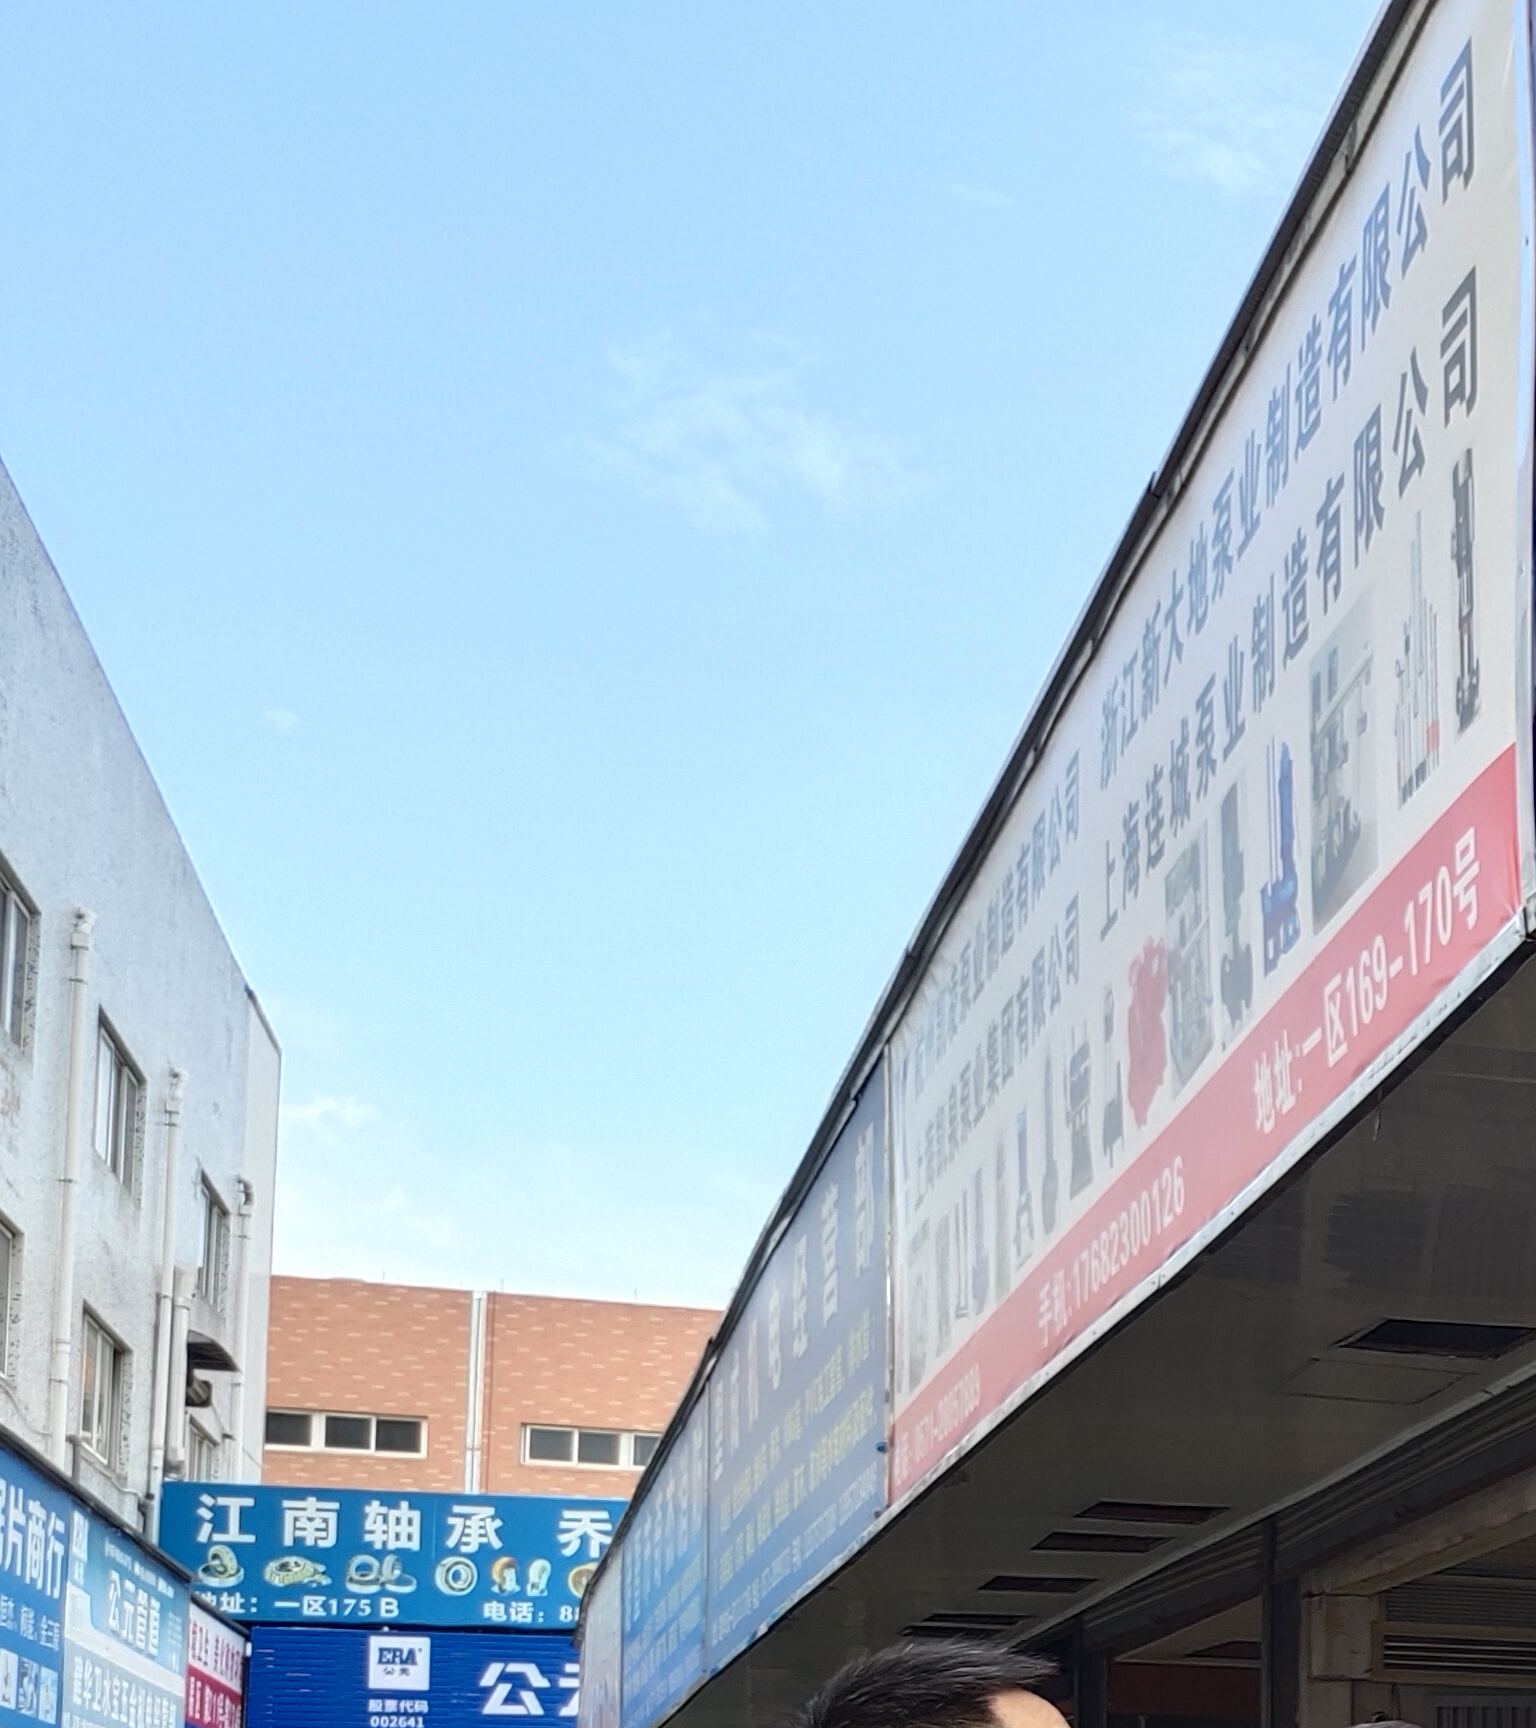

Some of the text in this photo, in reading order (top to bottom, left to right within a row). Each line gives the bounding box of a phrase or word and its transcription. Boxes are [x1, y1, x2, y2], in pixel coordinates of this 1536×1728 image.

[1101, 36, 1476, 790] 浙江新大地泵业制造有限公司
[1101, 266, 1478, 941] 上海连城泵业制造有限公司
[196, 1492, 502, 1552] 江南轴承
[377, 1647, 419, 1665] ERA
[367, 1699, 429, 1714] 股票代码
[369, 1715, 425, 1728] 002641
